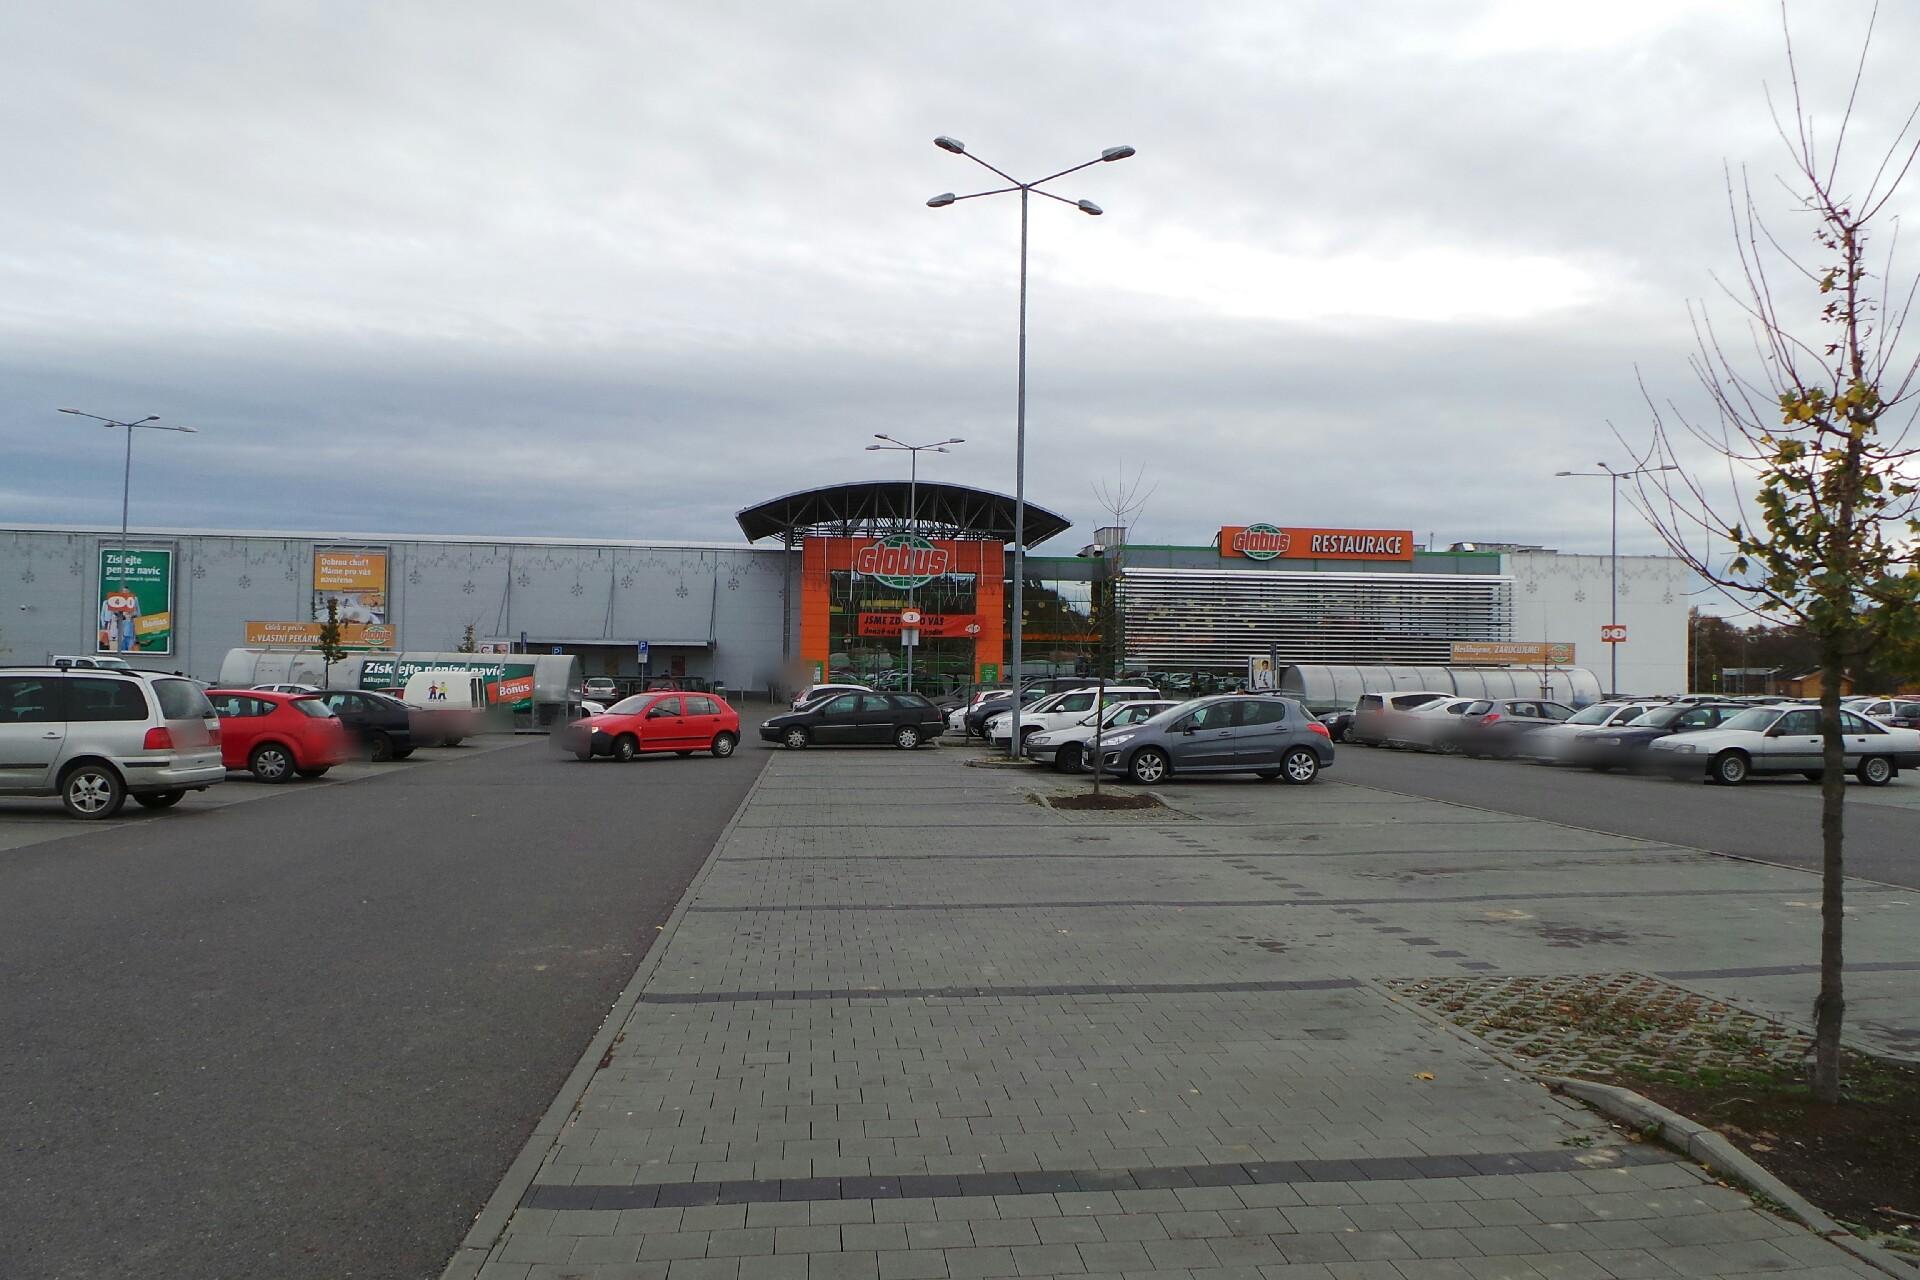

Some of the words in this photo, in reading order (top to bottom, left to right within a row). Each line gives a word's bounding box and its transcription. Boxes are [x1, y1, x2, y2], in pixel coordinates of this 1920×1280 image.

[1234, 530, 1290, 551] Globus
[1312, 535, 1402, 554] RESTAURACE
[859, 544, 948, 575] Globus
[106, 566, 135, 576] penze
[864, 615, 887, 625] JSME
[889, 616, 903, 625] ZD
[288, 633, 321, 643] PEKÁRN
[364, 662, 422, 677] Získejte
[470, 665, 506, 676] navíc
[499, 684, 530, 697] Bonus
